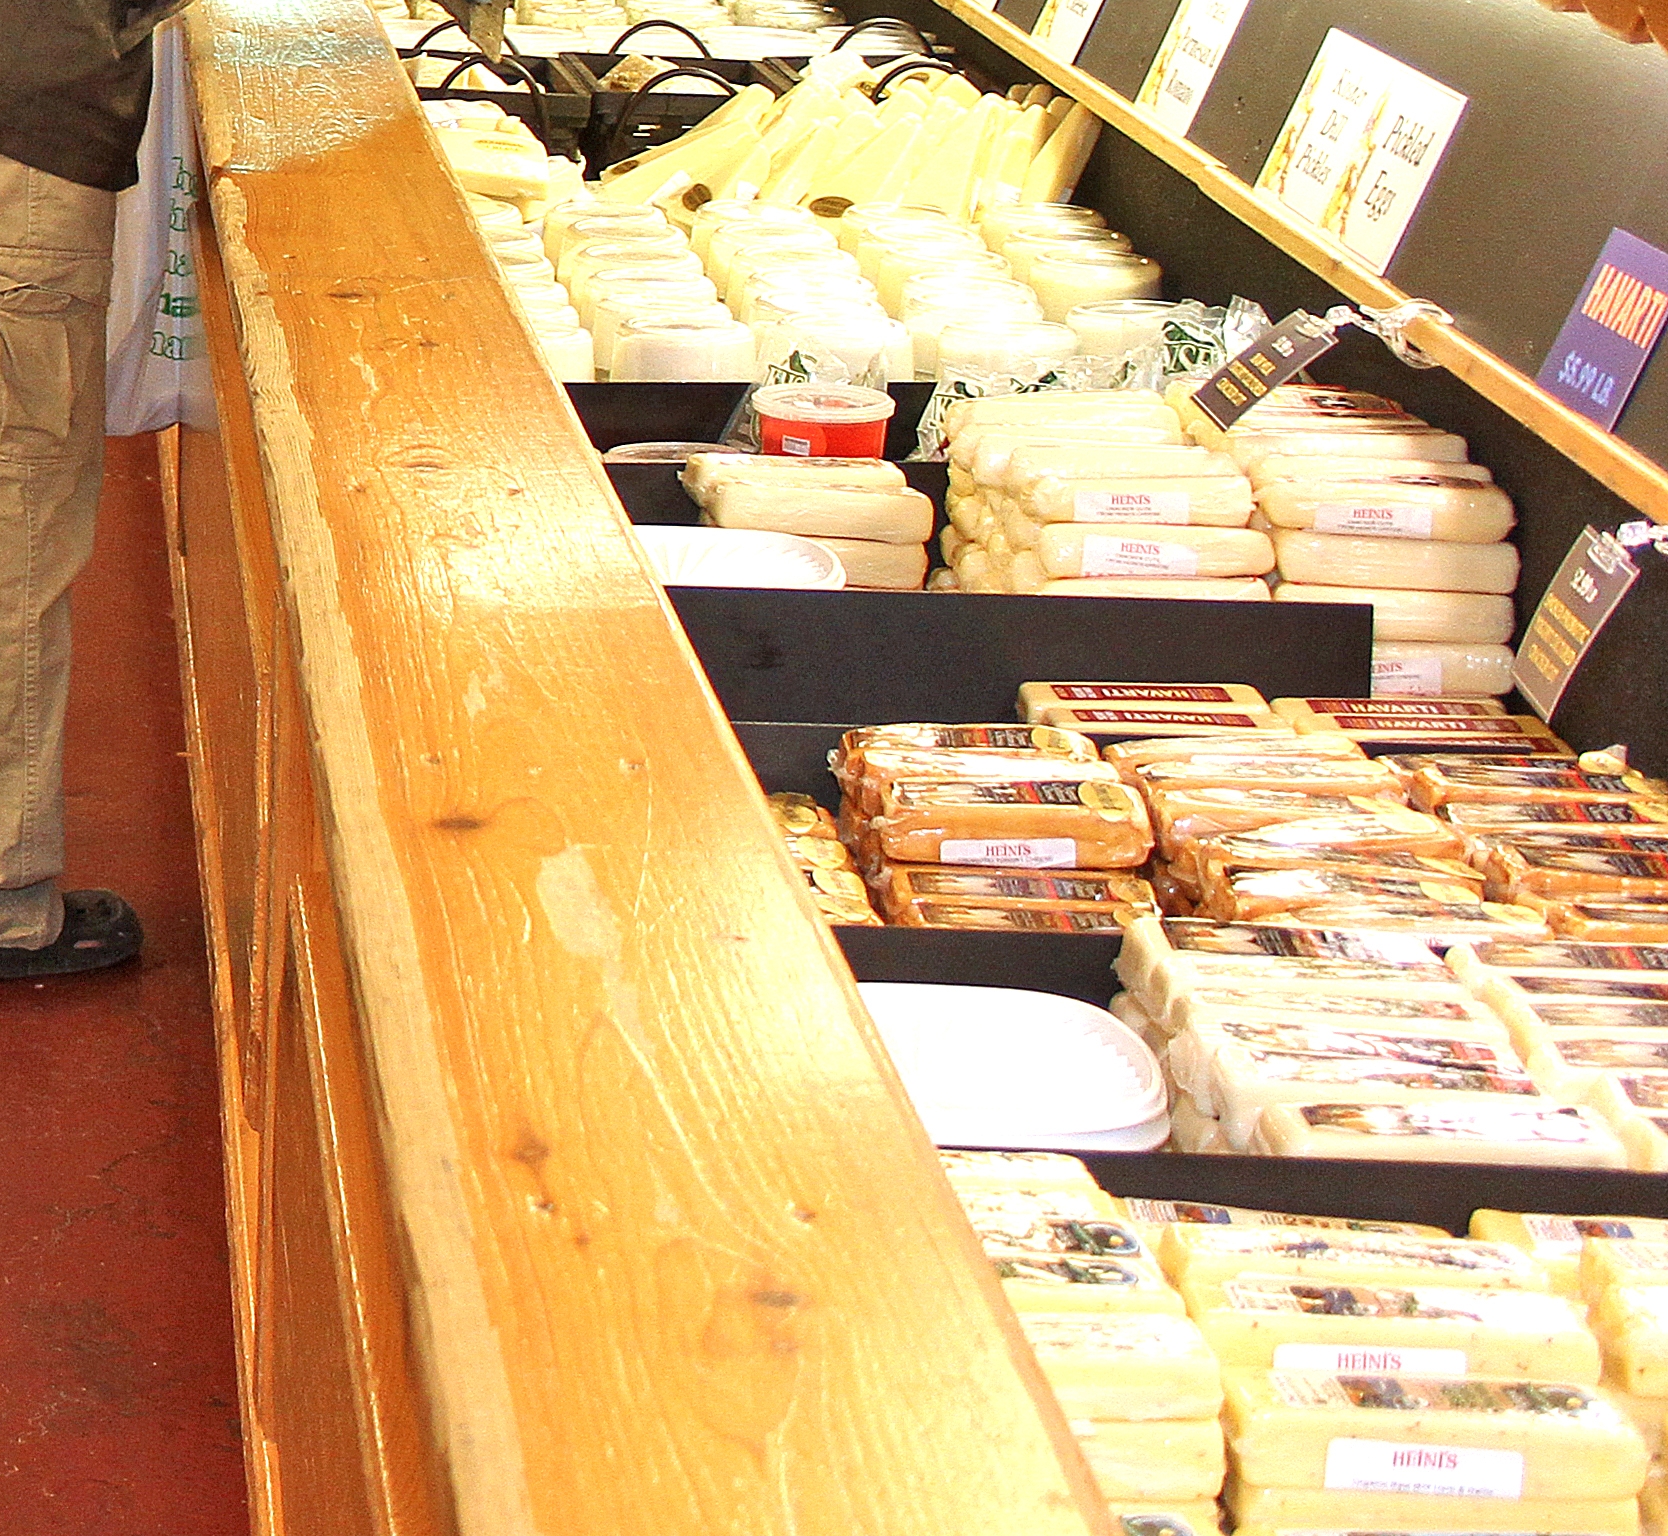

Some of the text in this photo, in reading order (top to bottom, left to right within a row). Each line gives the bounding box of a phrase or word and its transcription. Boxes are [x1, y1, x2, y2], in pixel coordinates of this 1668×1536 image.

[1319, 109, 1349, 142] Dill
[1382, 114, 1436, 168] Pickled
[1295, 143, 1332, 185] Pickles
[1364, 169, 1397, 222] Eggs
[1581, 263, 1668, 350] HAVARTI
[1557, 350, 1599, 394] $5.99
[1101, 687, 1190, 698] HAVARTI
[1349, 702, 1440, 714] HAVARTI
[1123, 711, 1214, 722] HAVARTI
[1376, 719, 1467, 729] HAVARTI
